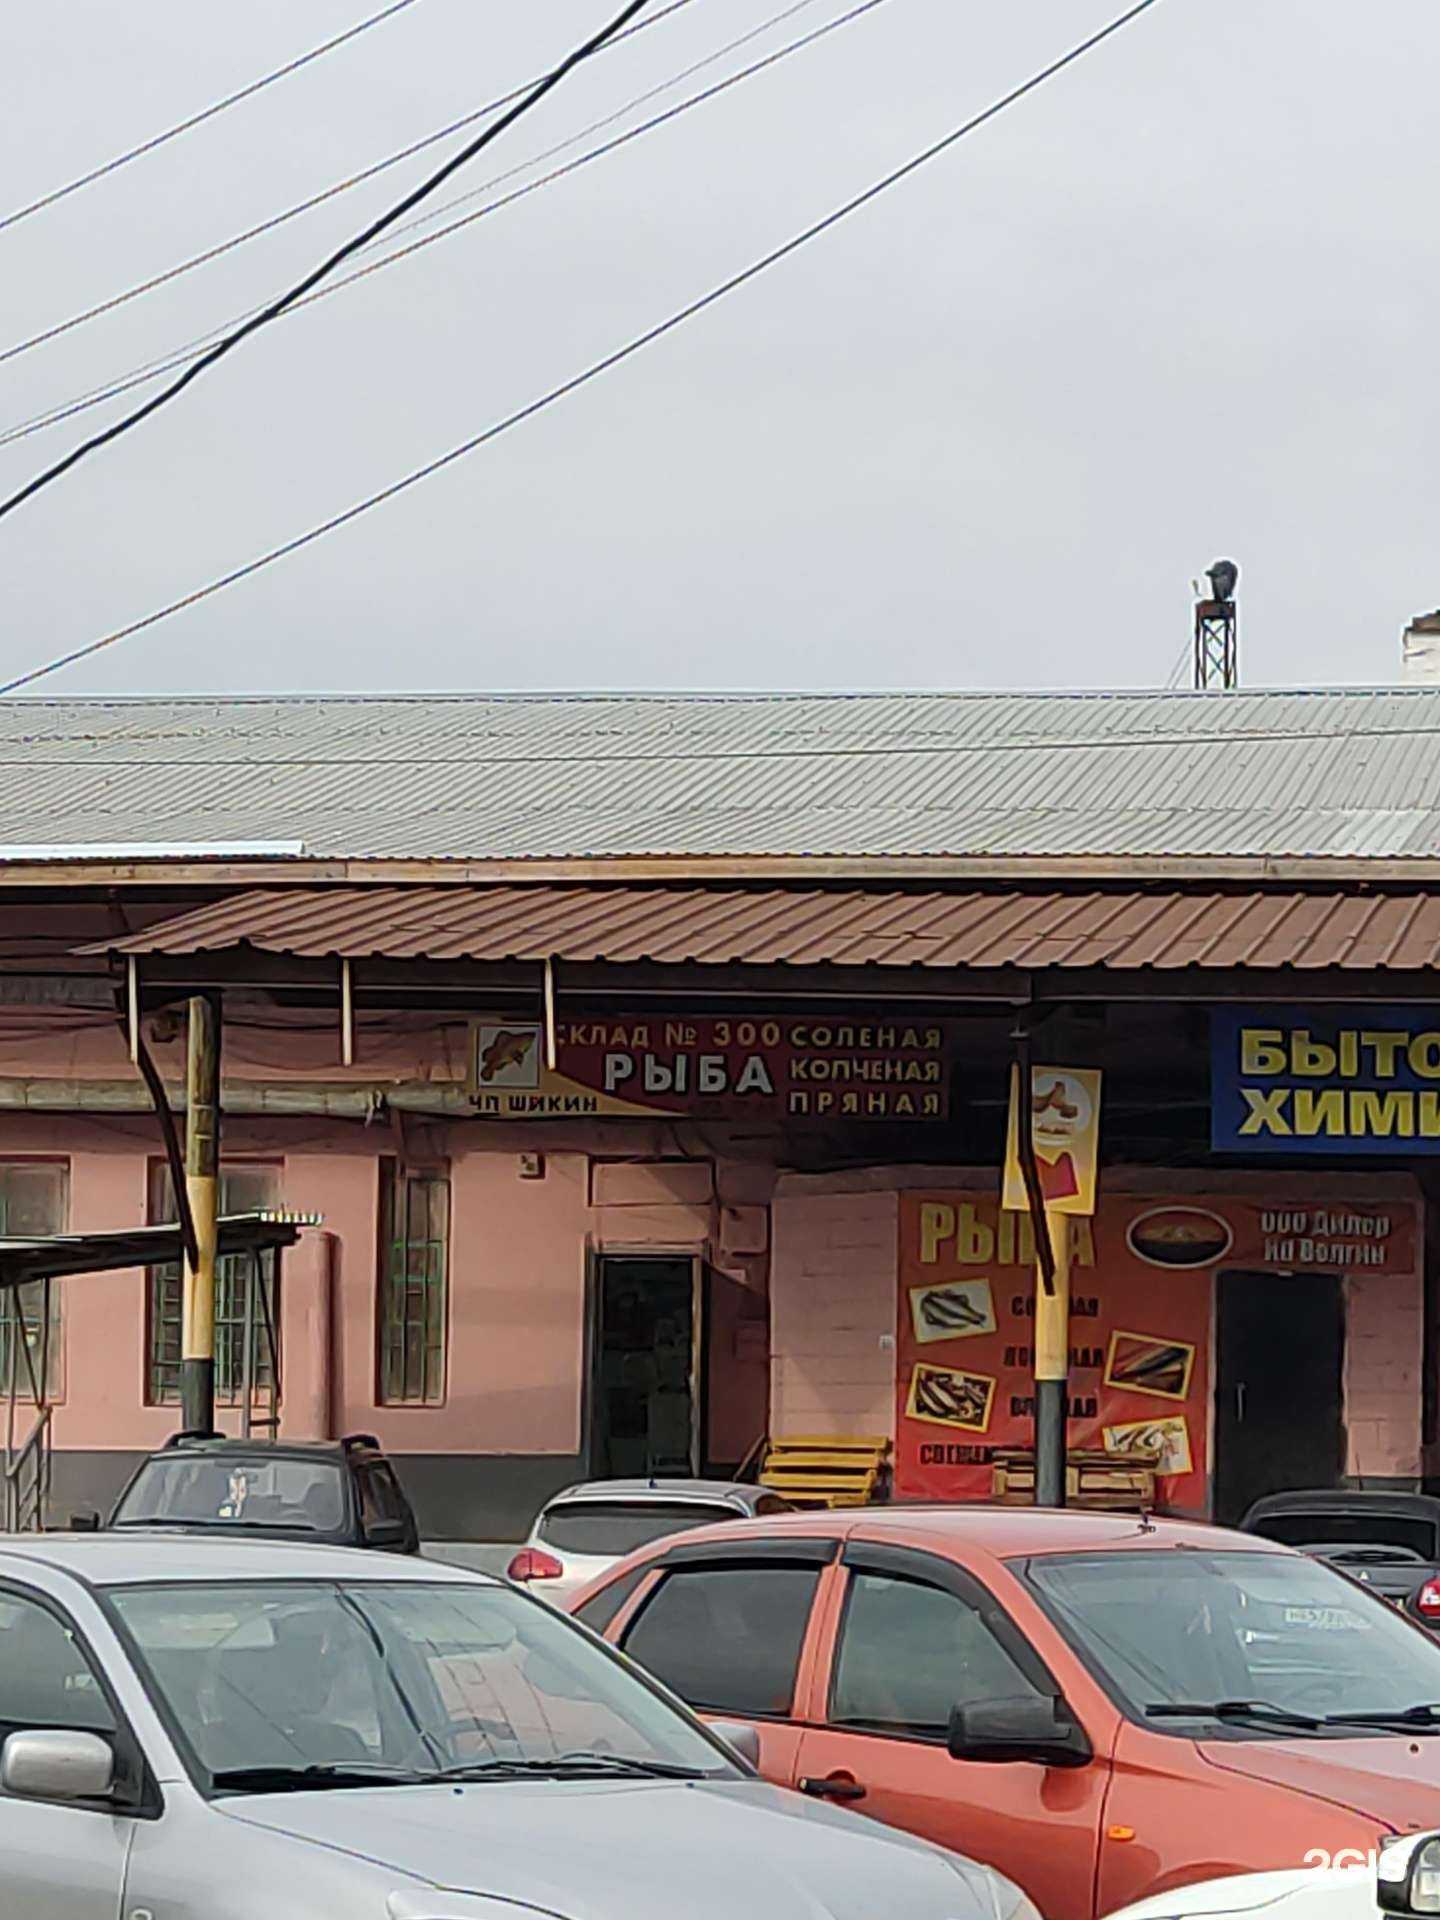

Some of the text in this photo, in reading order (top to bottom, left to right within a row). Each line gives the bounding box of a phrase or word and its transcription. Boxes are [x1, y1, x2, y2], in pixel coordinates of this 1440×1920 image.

[664, 1022, 698, 1046] №
[712, 1021, 780, 1047] 300
[790, 1026, 941, 1049] СОЛЕНАЯ
[605, 1053, 773, 1093] РЫБА
[790, 1057, 940, 1082] КОПЧЕНАЯ
[469, 1095, 597, 1112] ЧП ШИКИН
[789, 1091, 938, 1114] ПРЯНАЯ
